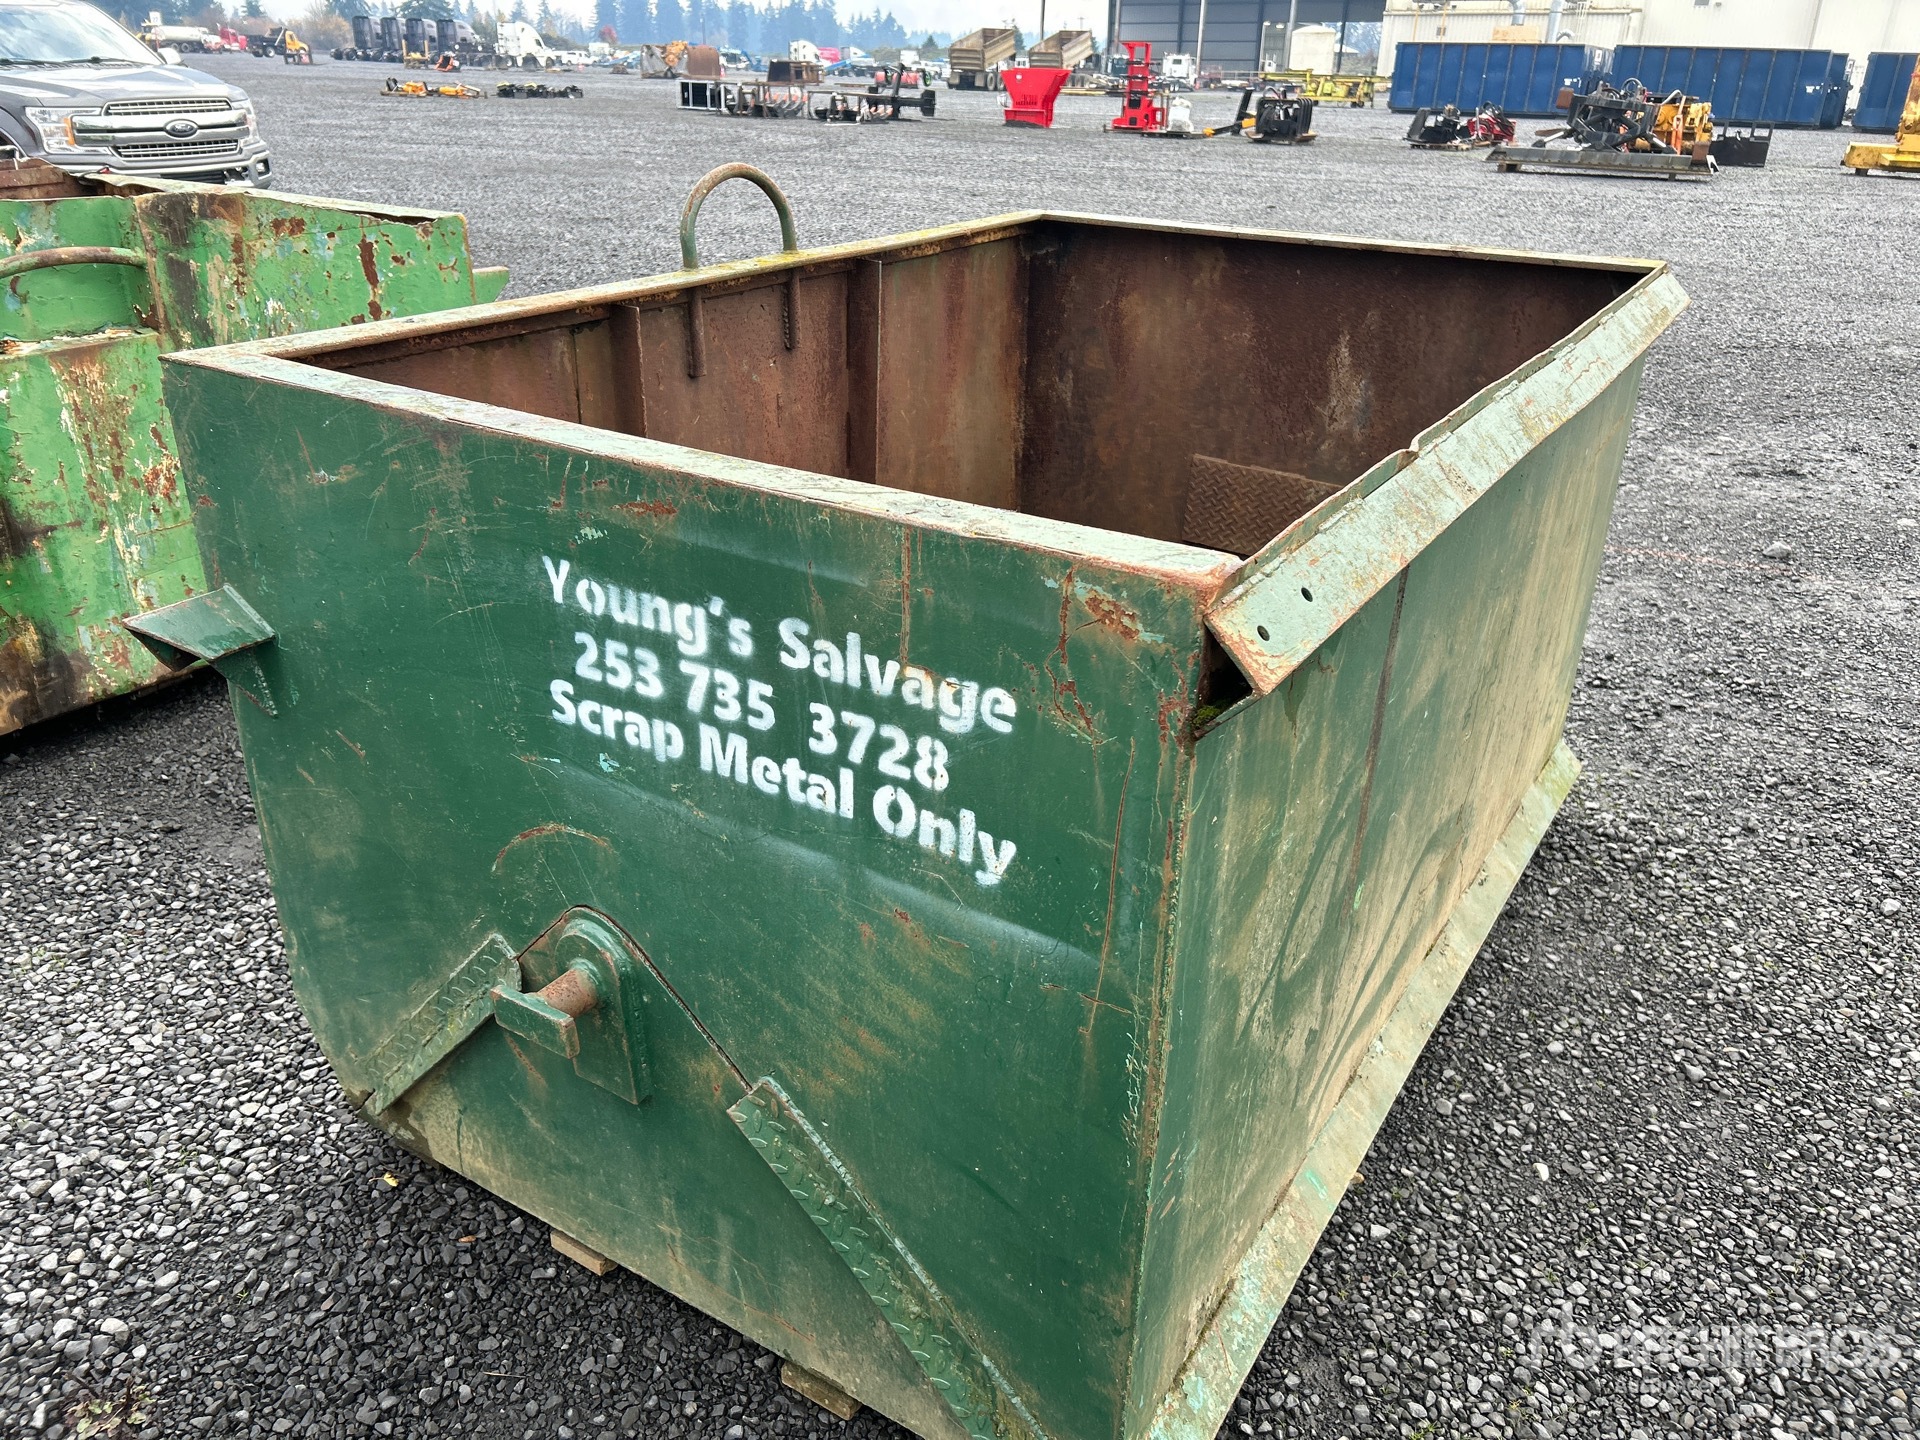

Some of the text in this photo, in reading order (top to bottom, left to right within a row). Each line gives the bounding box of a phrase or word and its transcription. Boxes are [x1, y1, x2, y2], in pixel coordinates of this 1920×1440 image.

[541, 555, 1017, 733] Young's Salvage
[573, 631, 950, 791] 253 735 3728
[549, 678, 1017, 887] Scrap Metal Only
